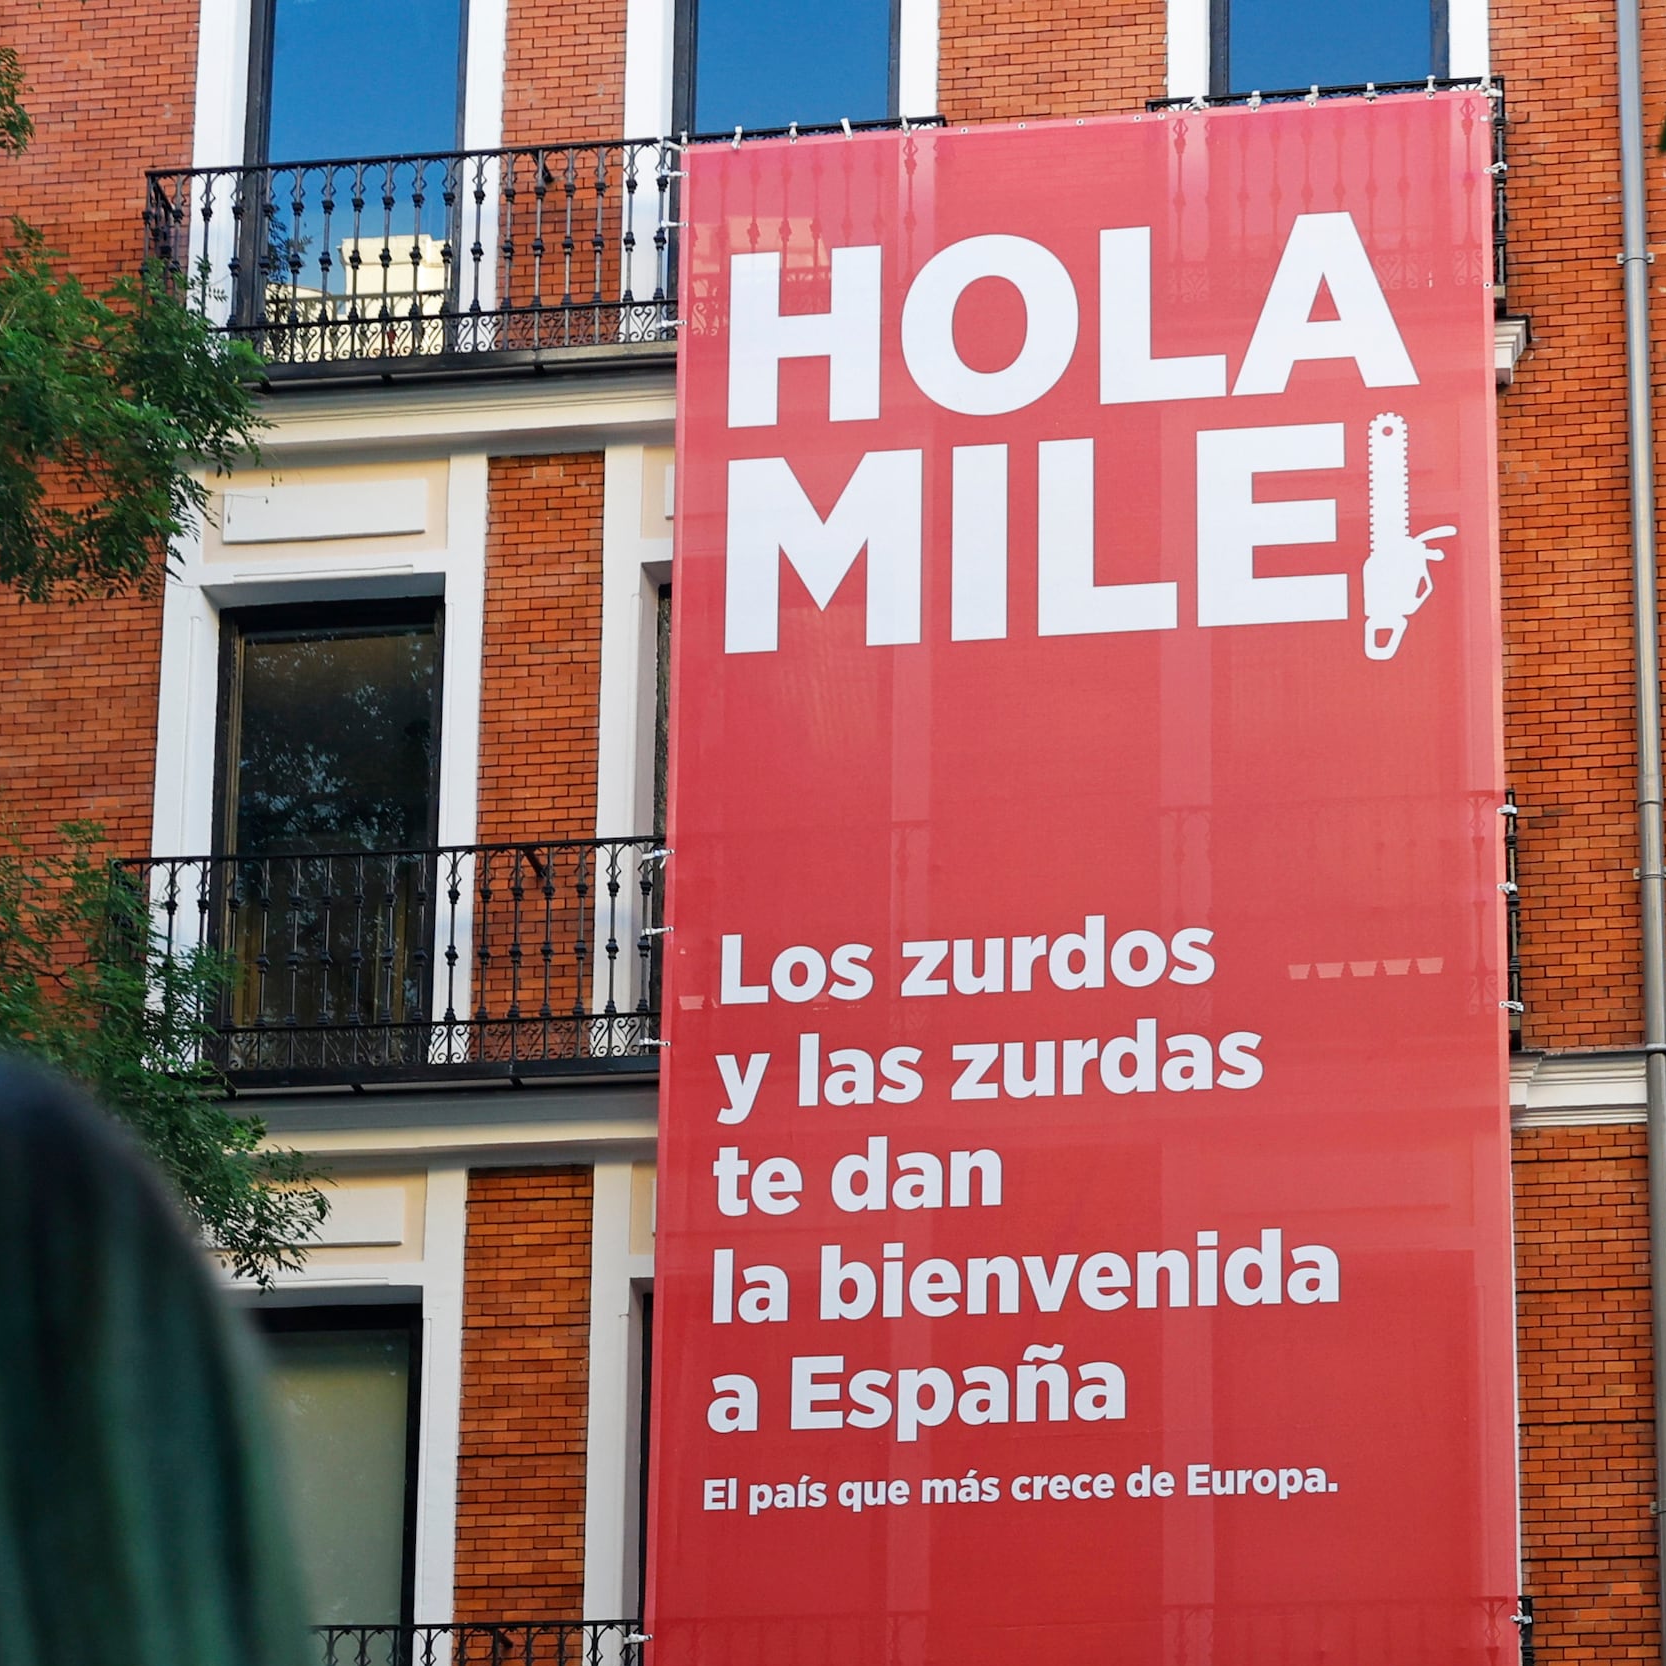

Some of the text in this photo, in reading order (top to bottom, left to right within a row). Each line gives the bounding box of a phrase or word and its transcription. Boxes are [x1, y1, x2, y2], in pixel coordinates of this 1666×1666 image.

[727, 211, 1421, 430] HOLA
[719, 914, 1216, 1006] Los zurdos
[715, 1017, 1265, 1126] y las zurdas
[712, 1135, 1004, 1218] te dan
[711, 1228, 1342, 1325] la bienvenida
[706, 1342, 1127, 1443] a España
[703, 1463, 1339, 1516] El país que más crece de Europa.
